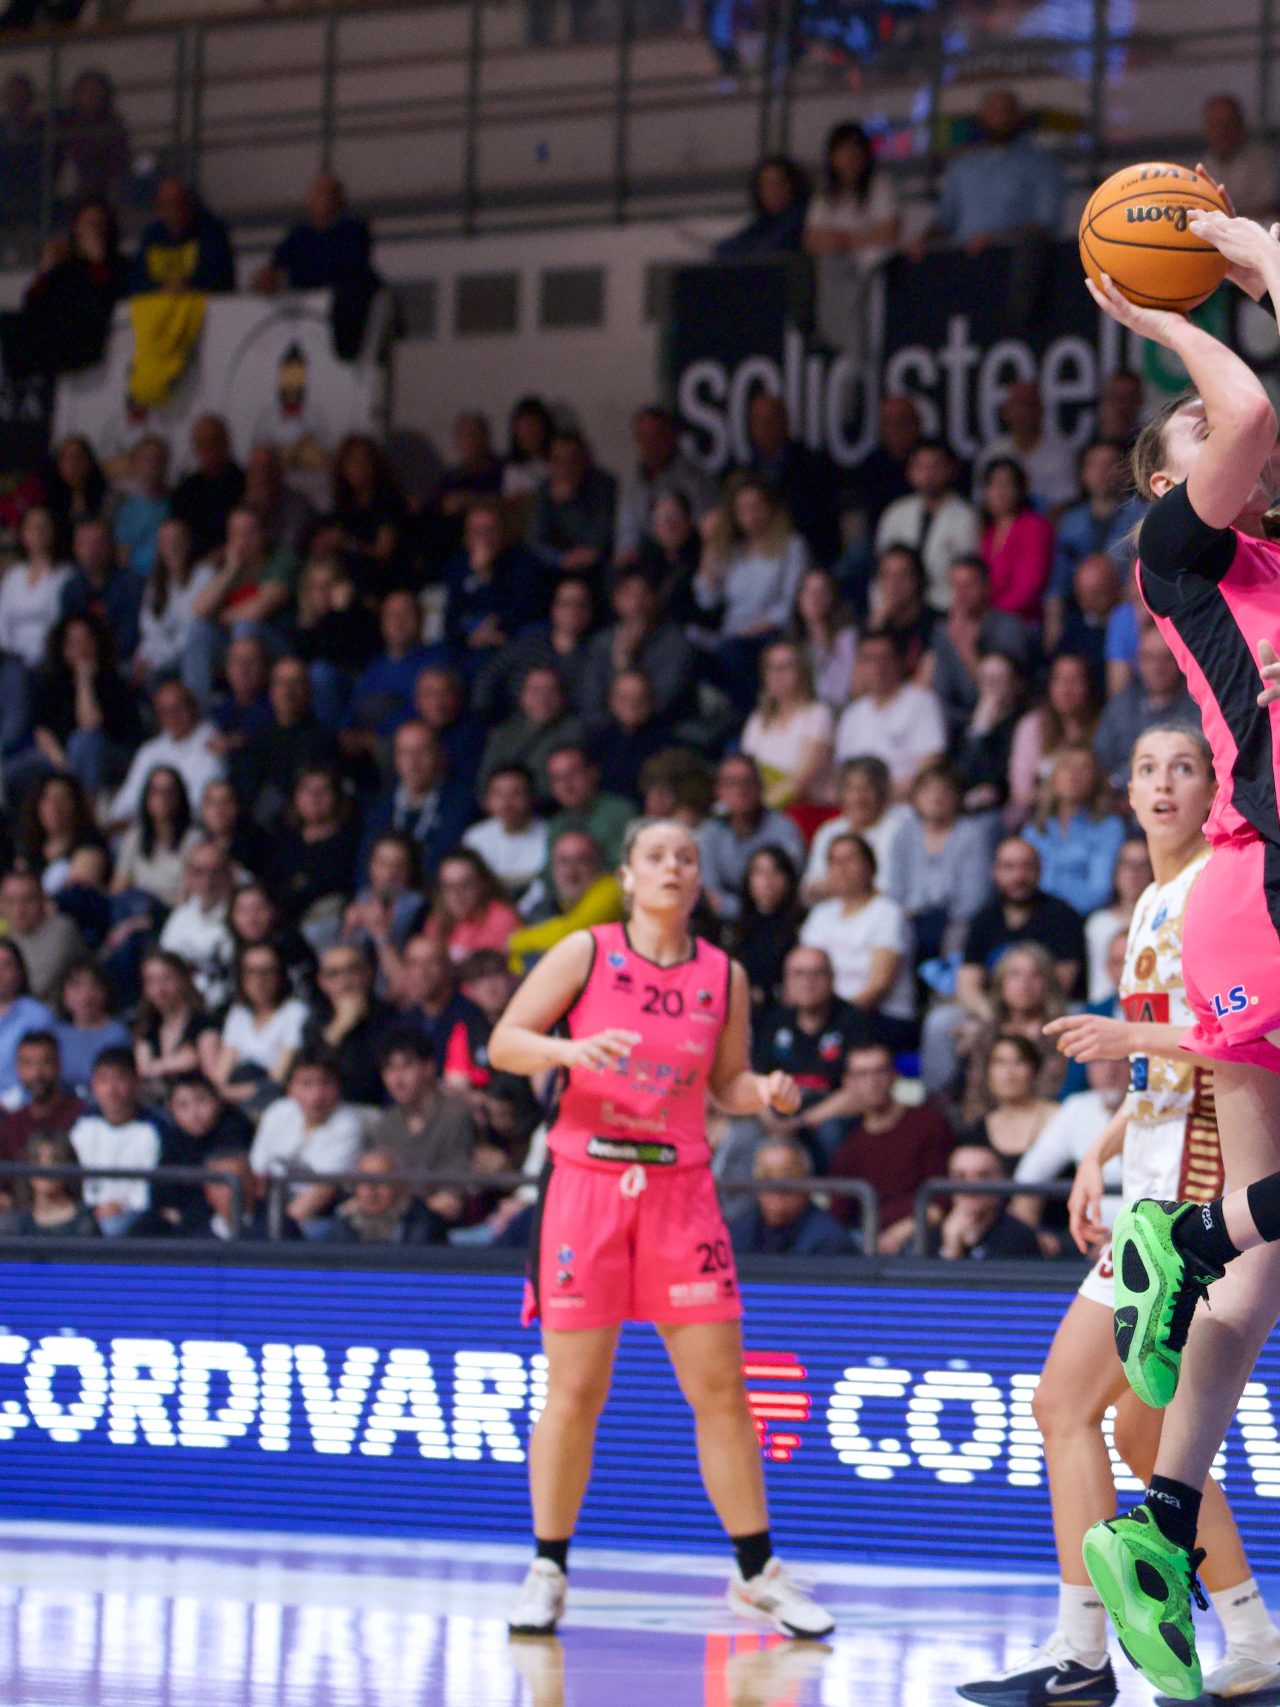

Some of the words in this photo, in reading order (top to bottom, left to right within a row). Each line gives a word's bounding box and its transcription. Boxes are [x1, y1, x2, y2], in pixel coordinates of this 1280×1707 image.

[1125, 204, 1194, 233] lson
[640, 985, 684, 1017] 20
[696, 1239, 730, 1274] 20
